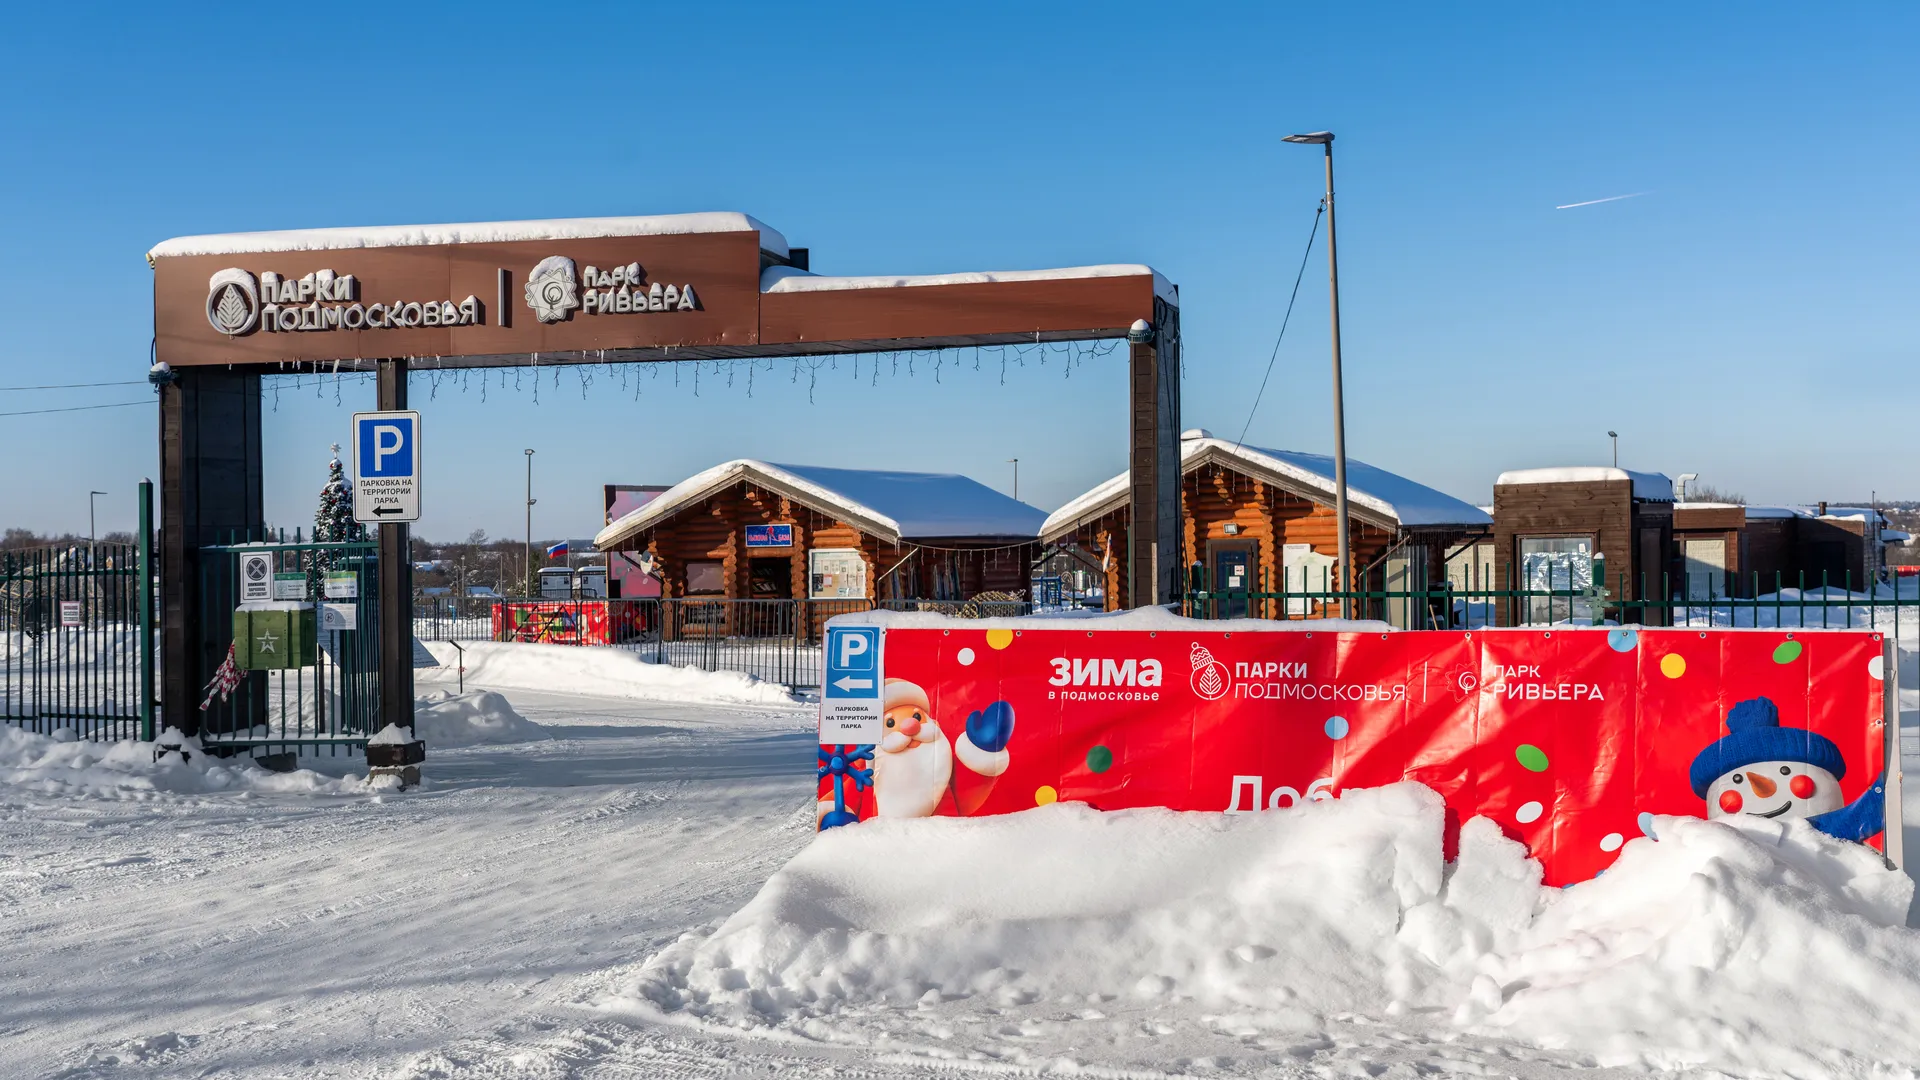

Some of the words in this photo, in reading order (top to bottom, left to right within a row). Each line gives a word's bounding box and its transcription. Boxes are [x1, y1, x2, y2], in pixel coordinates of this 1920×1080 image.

[583, 270, 641, 289] ПАРК
[262, 279, 354, 303] ПАРКИ
[583, 285, 696, 314] РИВЬЕРА
[262, 299, 479, 331] ПОДМОСКОВЬЯ
[374, 425, 404, 472] P
[360, 479, 400, 487] ПАРКОВКА
[362, 488, 411, 496] ТЕРРИТОРИИ
[841, 633, 868, 667] P
[1235, 662, 1308, 679] ПАРКИ
[1494, 665, 1541, 678] ПАРК
[1234, 683, 1406, 701] ПОДМОСКОВЬЯ
[1494, 684, 1605, 701] РИВЬЕРА
